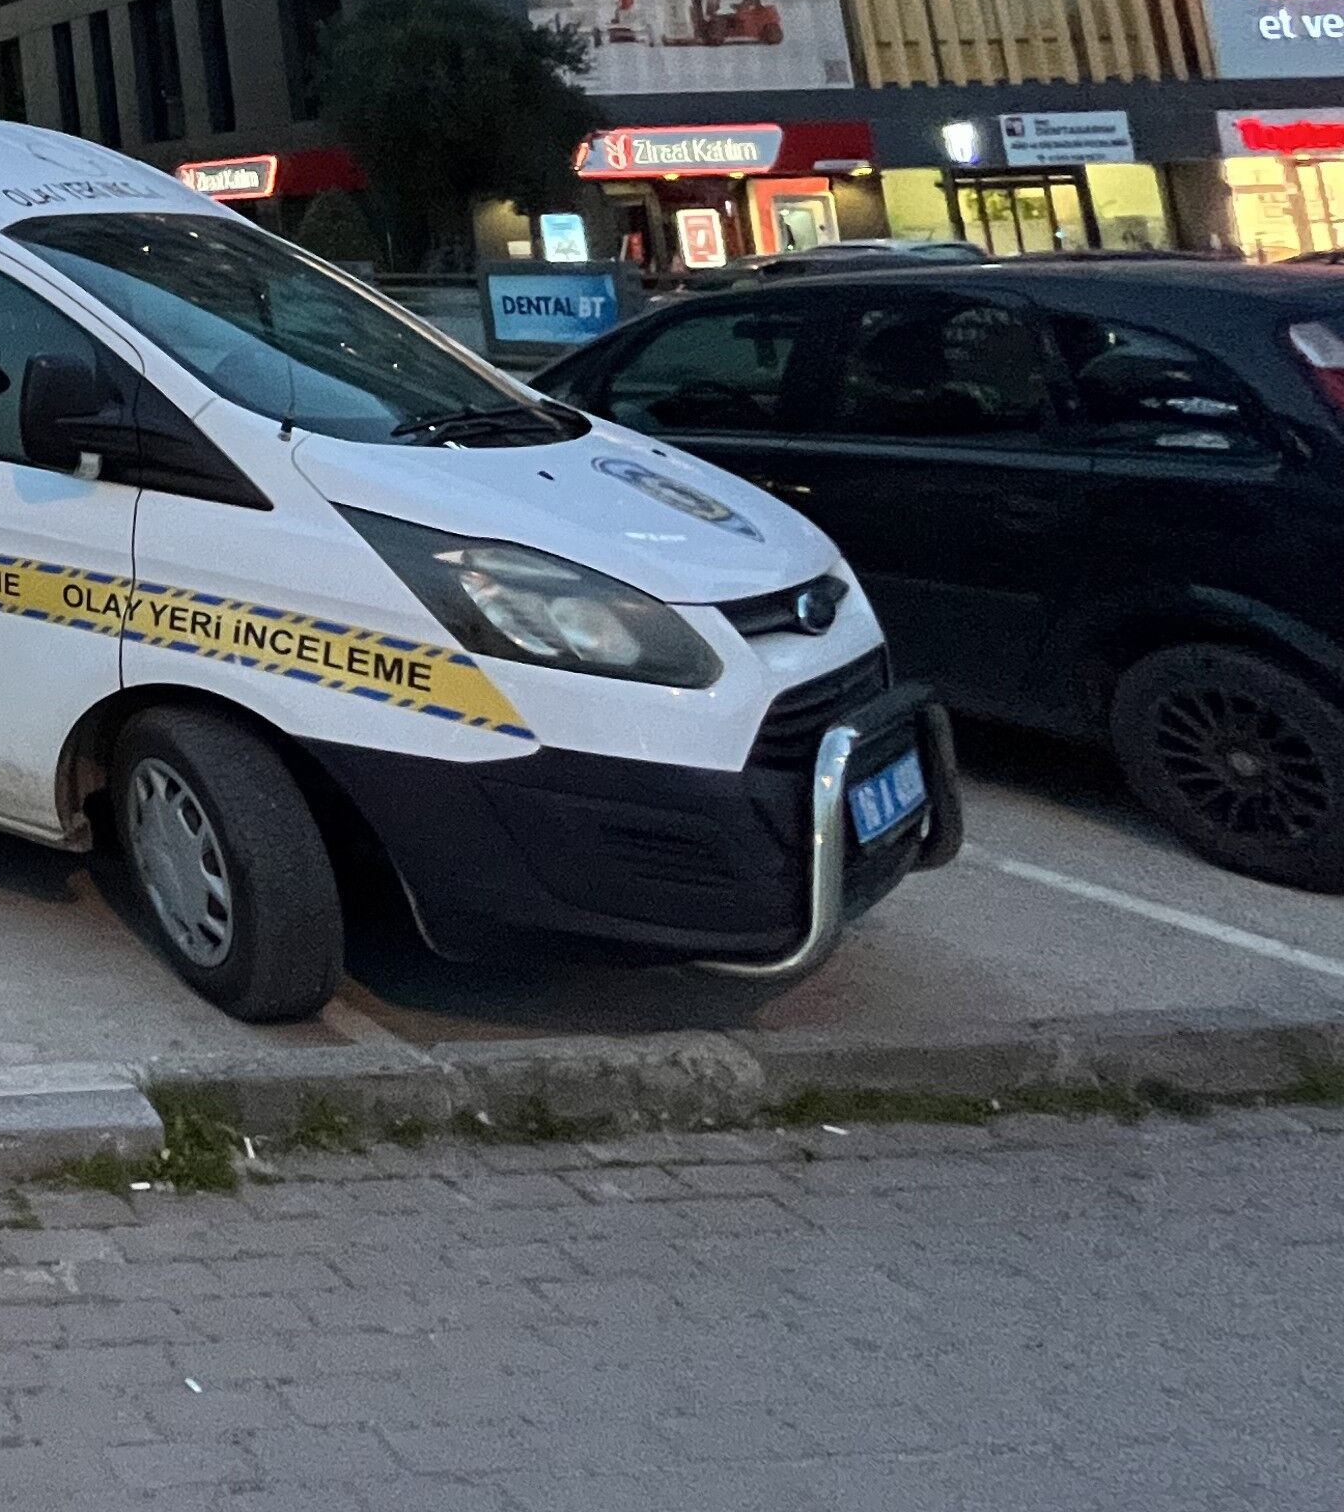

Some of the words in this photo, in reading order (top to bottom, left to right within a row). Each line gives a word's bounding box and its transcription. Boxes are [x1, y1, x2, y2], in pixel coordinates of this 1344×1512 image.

[1259, 7, 1297, 40] et
[501, 295, 576, 317] DENTAL
[61, 583, 143, 622] OLAY
